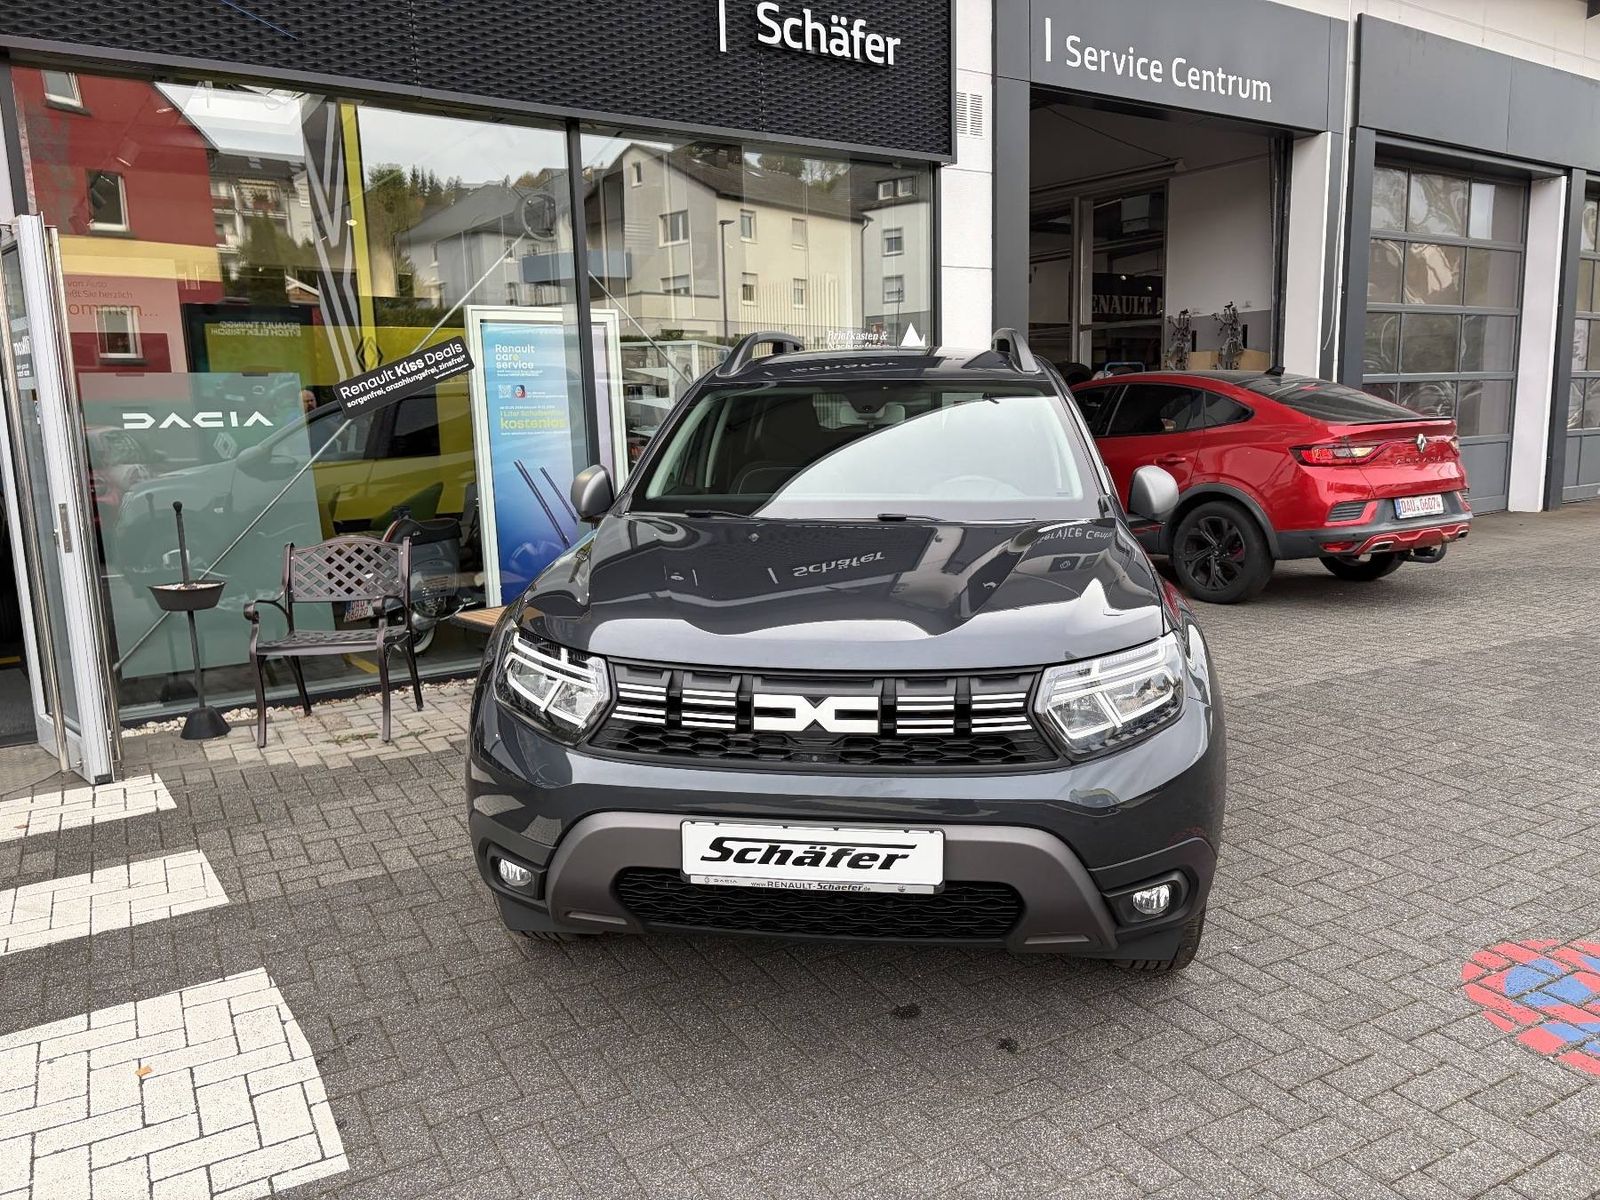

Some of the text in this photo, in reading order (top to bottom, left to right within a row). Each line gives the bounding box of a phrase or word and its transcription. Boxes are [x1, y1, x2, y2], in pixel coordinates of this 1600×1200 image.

[756, 1, 901, 65] Schäfer
[1065, 35, 1272, 103] Service Centrum
[68, 304, 158, 317] ommen...
[1092, 294, 1153, 315] ENAULT
[495, 344, 536, 354] Renault
[495, 353, 519, 361] care
[339, 369, 396, 400] Renault
[395, 358, 425, 377] Kiss
[424, 342, 463, 365] Deals
[495, 360, 534, 370] service
[347, 386, 387, 408] sorgenfrei,
[385, 366, 440, 393] anzahlungsfrei,
[122, 410, 274, 430] DACIA
[500, 417, 567, 430] kostenlos
[700, 836, 917, 870] Schäfer
